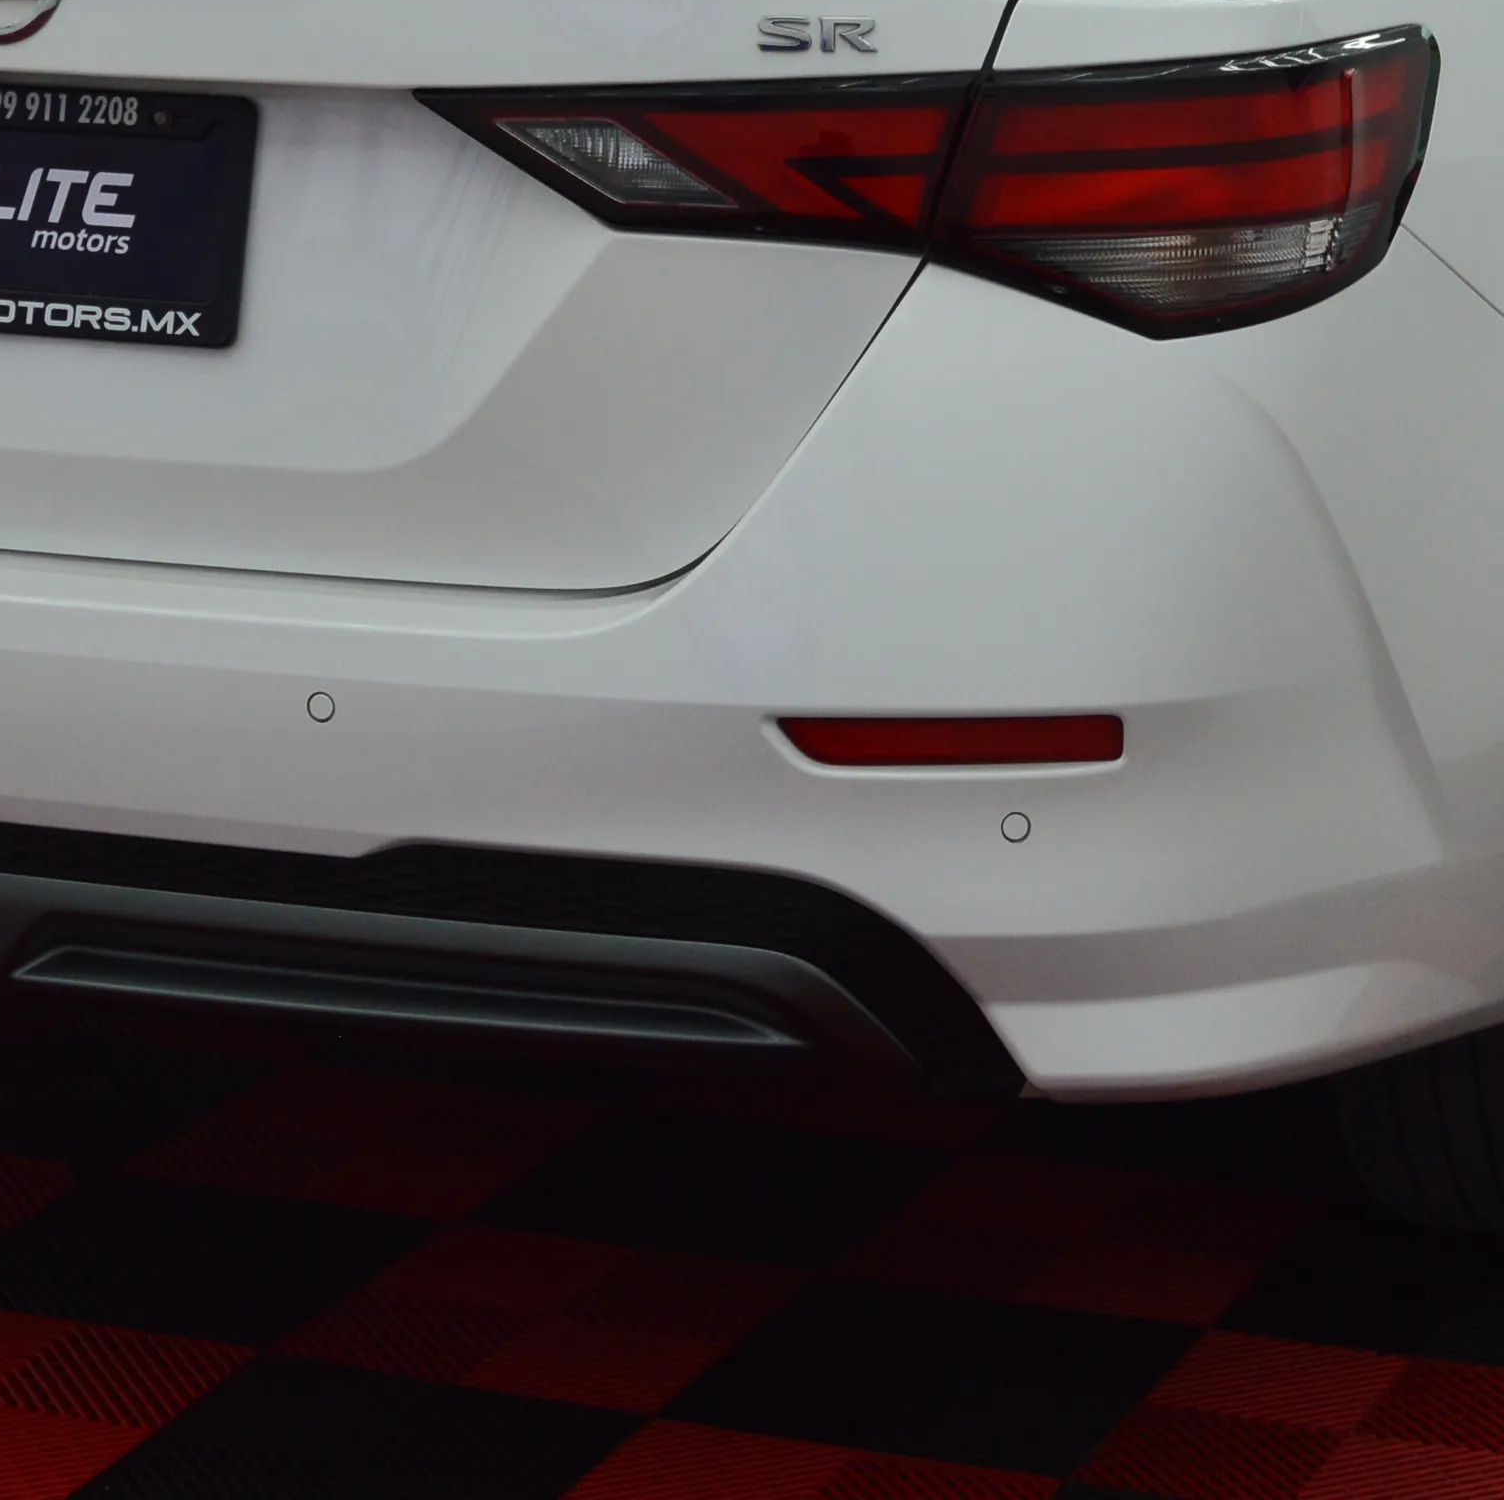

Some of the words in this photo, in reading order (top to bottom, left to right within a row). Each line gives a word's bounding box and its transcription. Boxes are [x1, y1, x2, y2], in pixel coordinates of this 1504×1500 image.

[756, 14, 879, 54] SR
[24, 91, 68, 124] 911
[78, 94, 139, 127] 2208
[30, 228, 131, 255] motors
